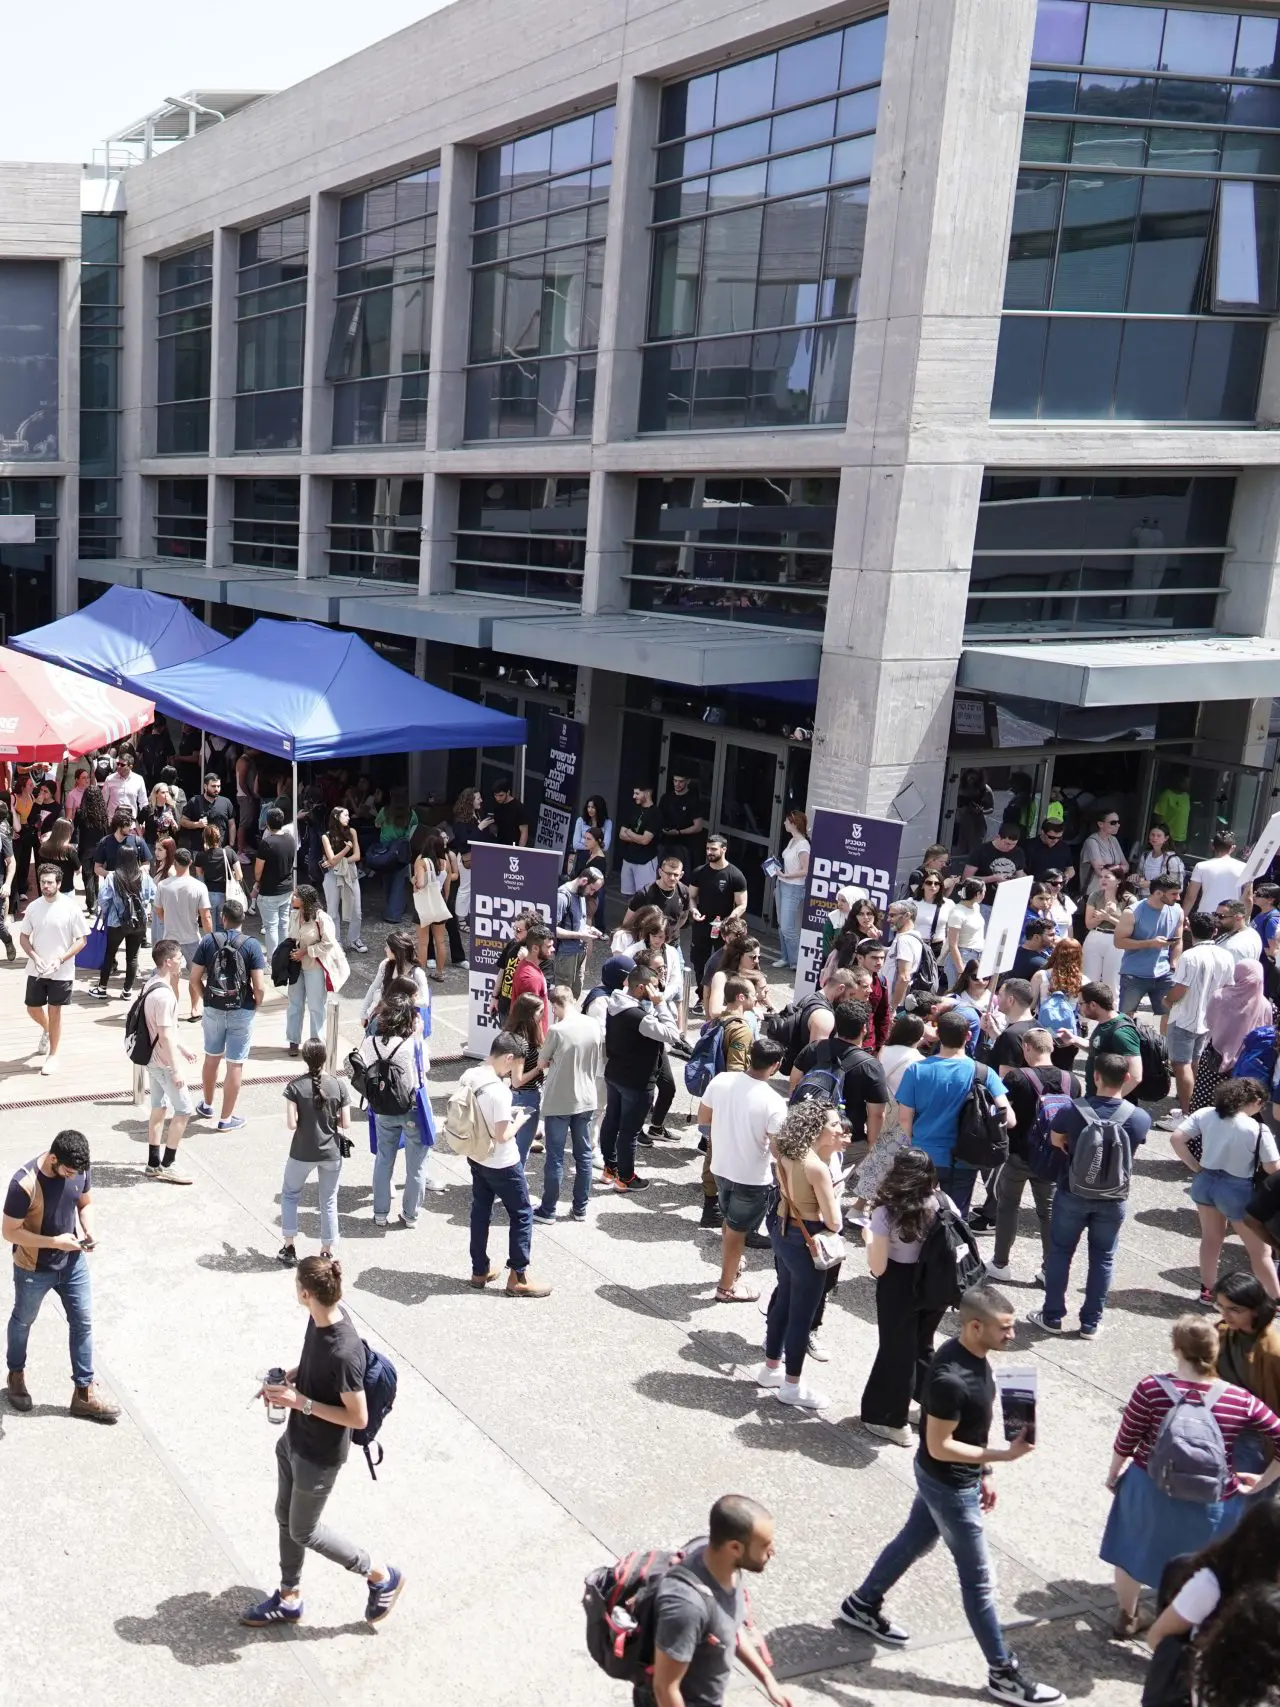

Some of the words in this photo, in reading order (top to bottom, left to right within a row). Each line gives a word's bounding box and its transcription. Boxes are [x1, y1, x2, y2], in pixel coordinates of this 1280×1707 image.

[552, 810, 569, 825] דברים
[540, 827, 554, 838] שהם
[844, 838, 866, 847] הטכניון
[503, 873, 525, 881] הטכניון
[812, 857, 890, 891] ברוכים
[810, 878, 888, 911] הים
[475, 894, 552, 924] ברוכים
[475, 916, 516, 940] אים
[481, 948, 502, 958] אולם
[471, 988, 493, 1003] מיד
[477, 1014, 502, 1030] אים
